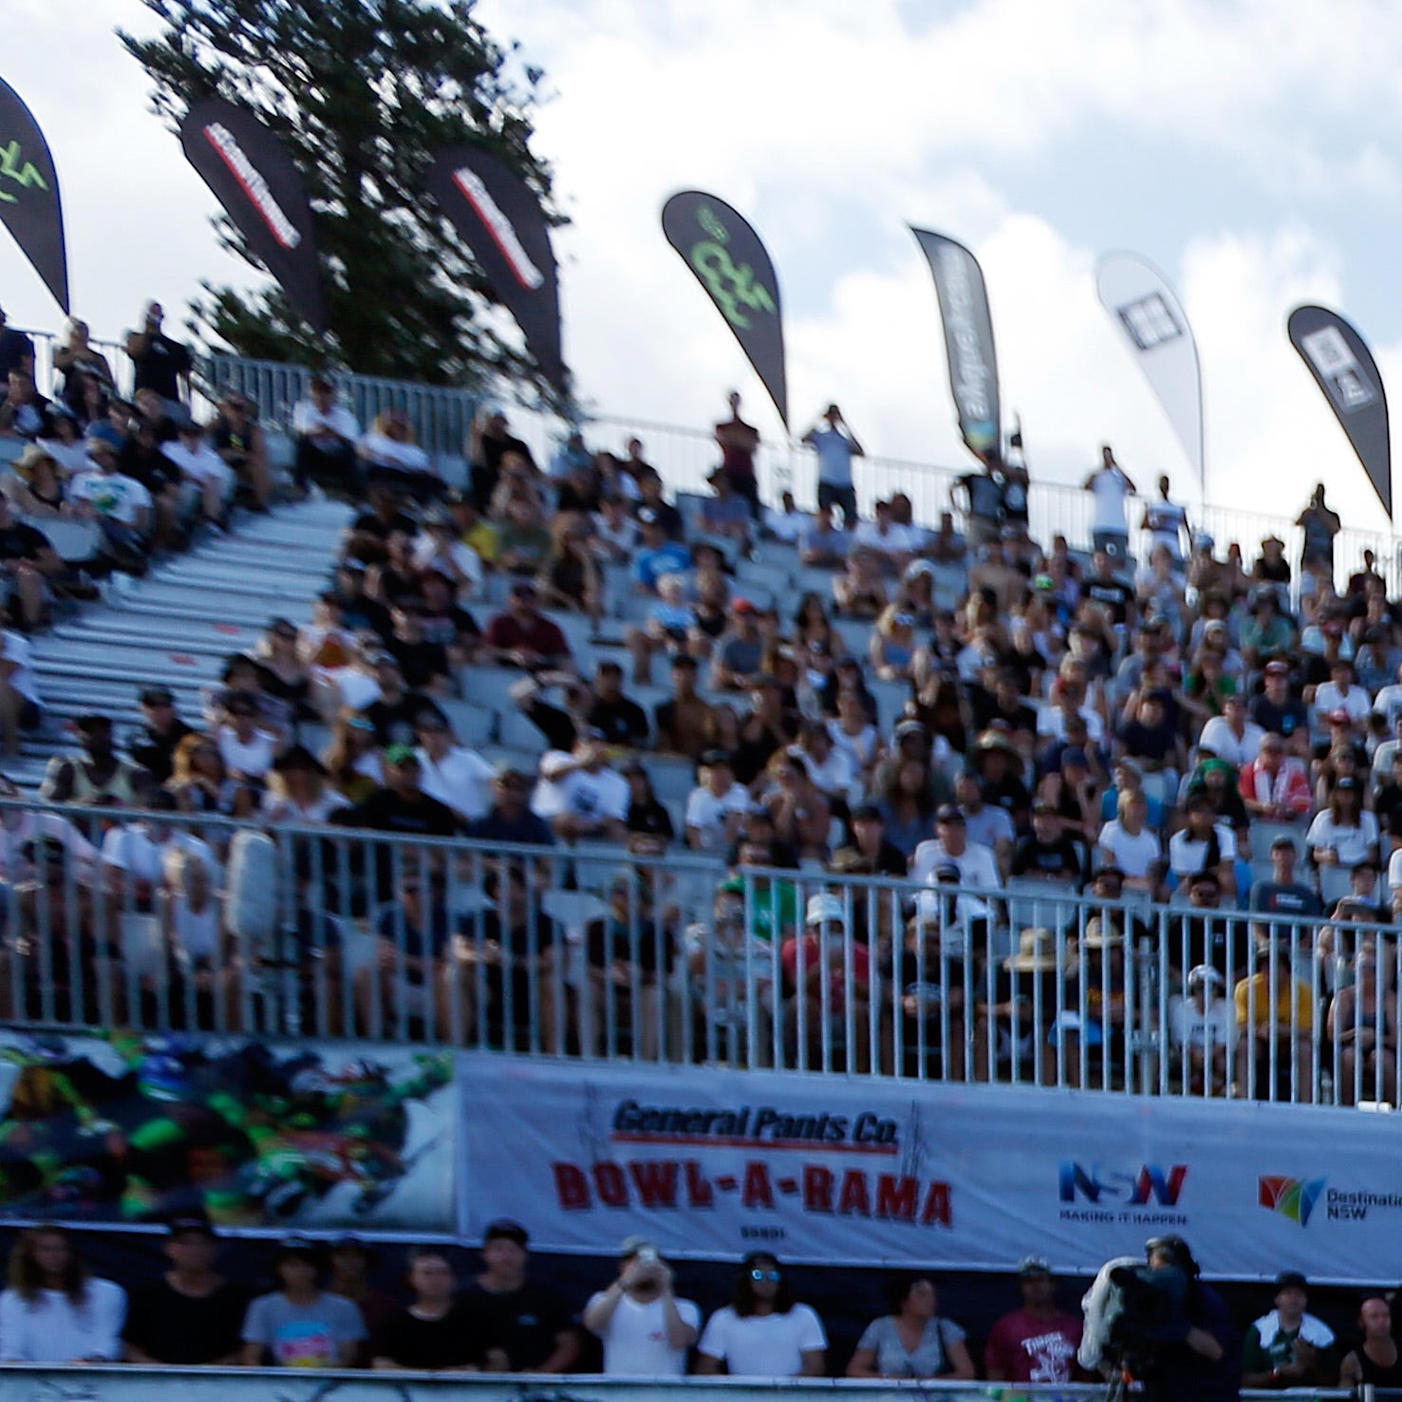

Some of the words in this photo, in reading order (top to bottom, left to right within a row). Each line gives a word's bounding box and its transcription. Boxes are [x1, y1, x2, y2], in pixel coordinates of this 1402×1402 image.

[612, 1099, 750, 1139] General
[752, 1106, 849, 1143] Pants
[853, 1111, 900, 1146] Co.
[551, 1158, 954, 1229] BOWL-A-RAMA
[1327, 1206, 1368, 1221] NSW
